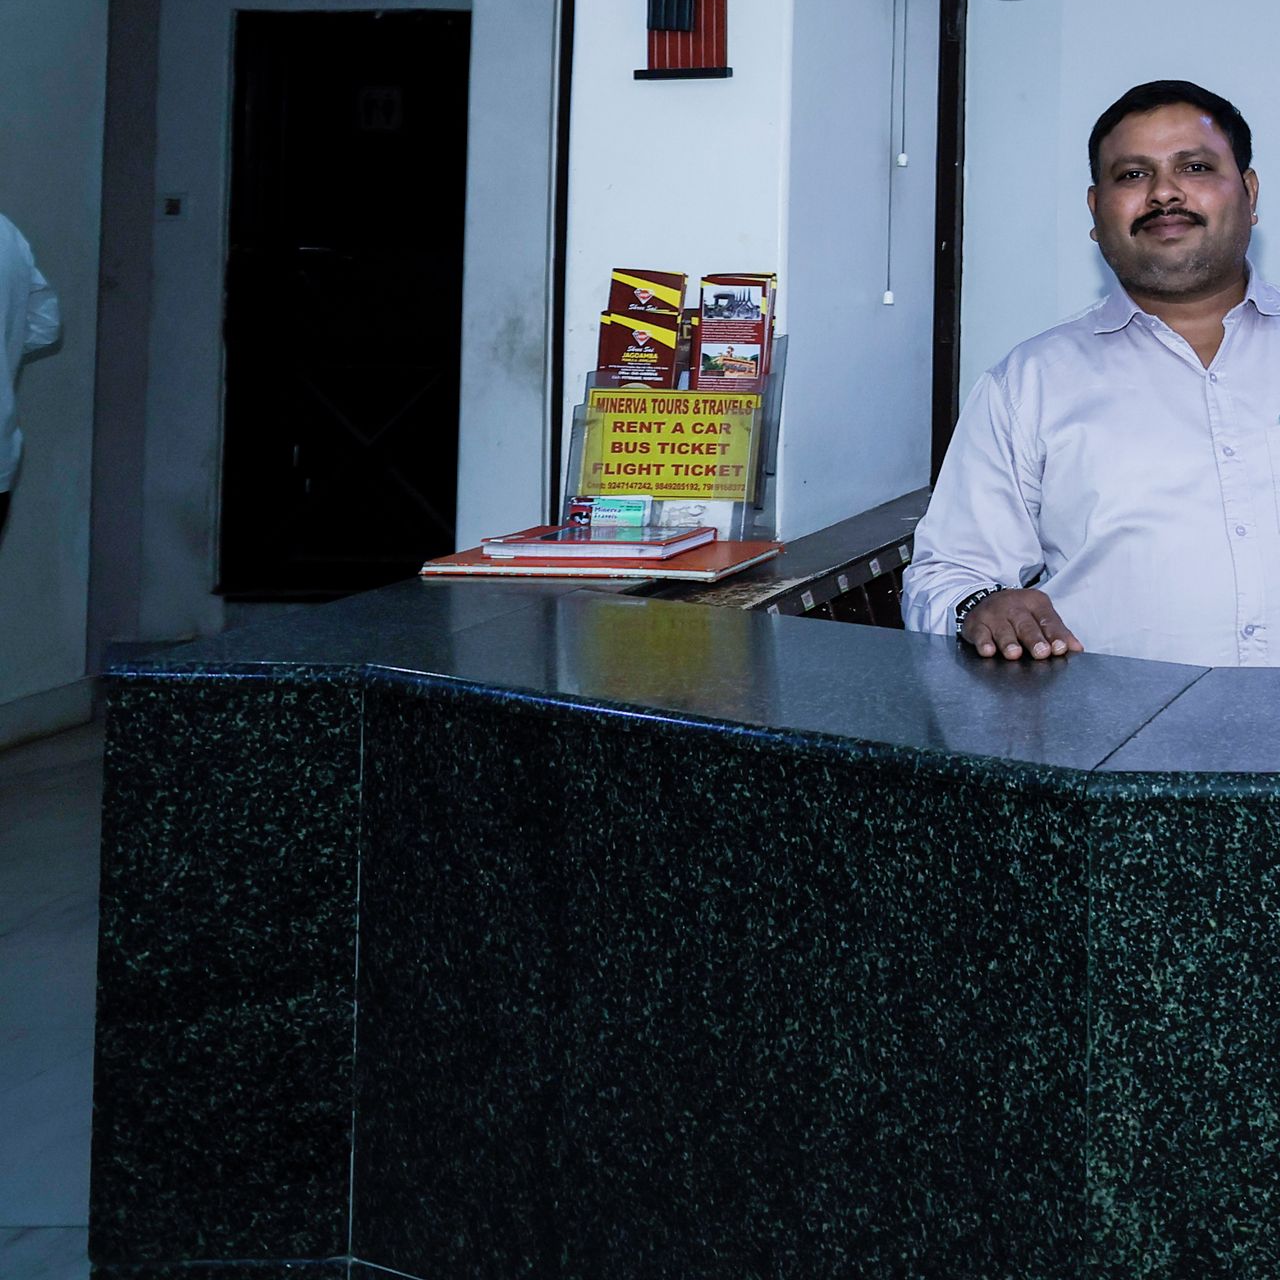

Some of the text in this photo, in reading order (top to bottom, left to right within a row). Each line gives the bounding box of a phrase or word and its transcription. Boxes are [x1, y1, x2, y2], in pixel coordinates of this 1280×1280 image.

[596, 398, 646, 414] MINERVA
[652, 398, 689, 414] TOURS
[613, 422, 731, 434] RENT A CAR
[611, 442, 730, 455] BUS TICKET
[593, 463, 744, 477] FLIGHT TICKET
